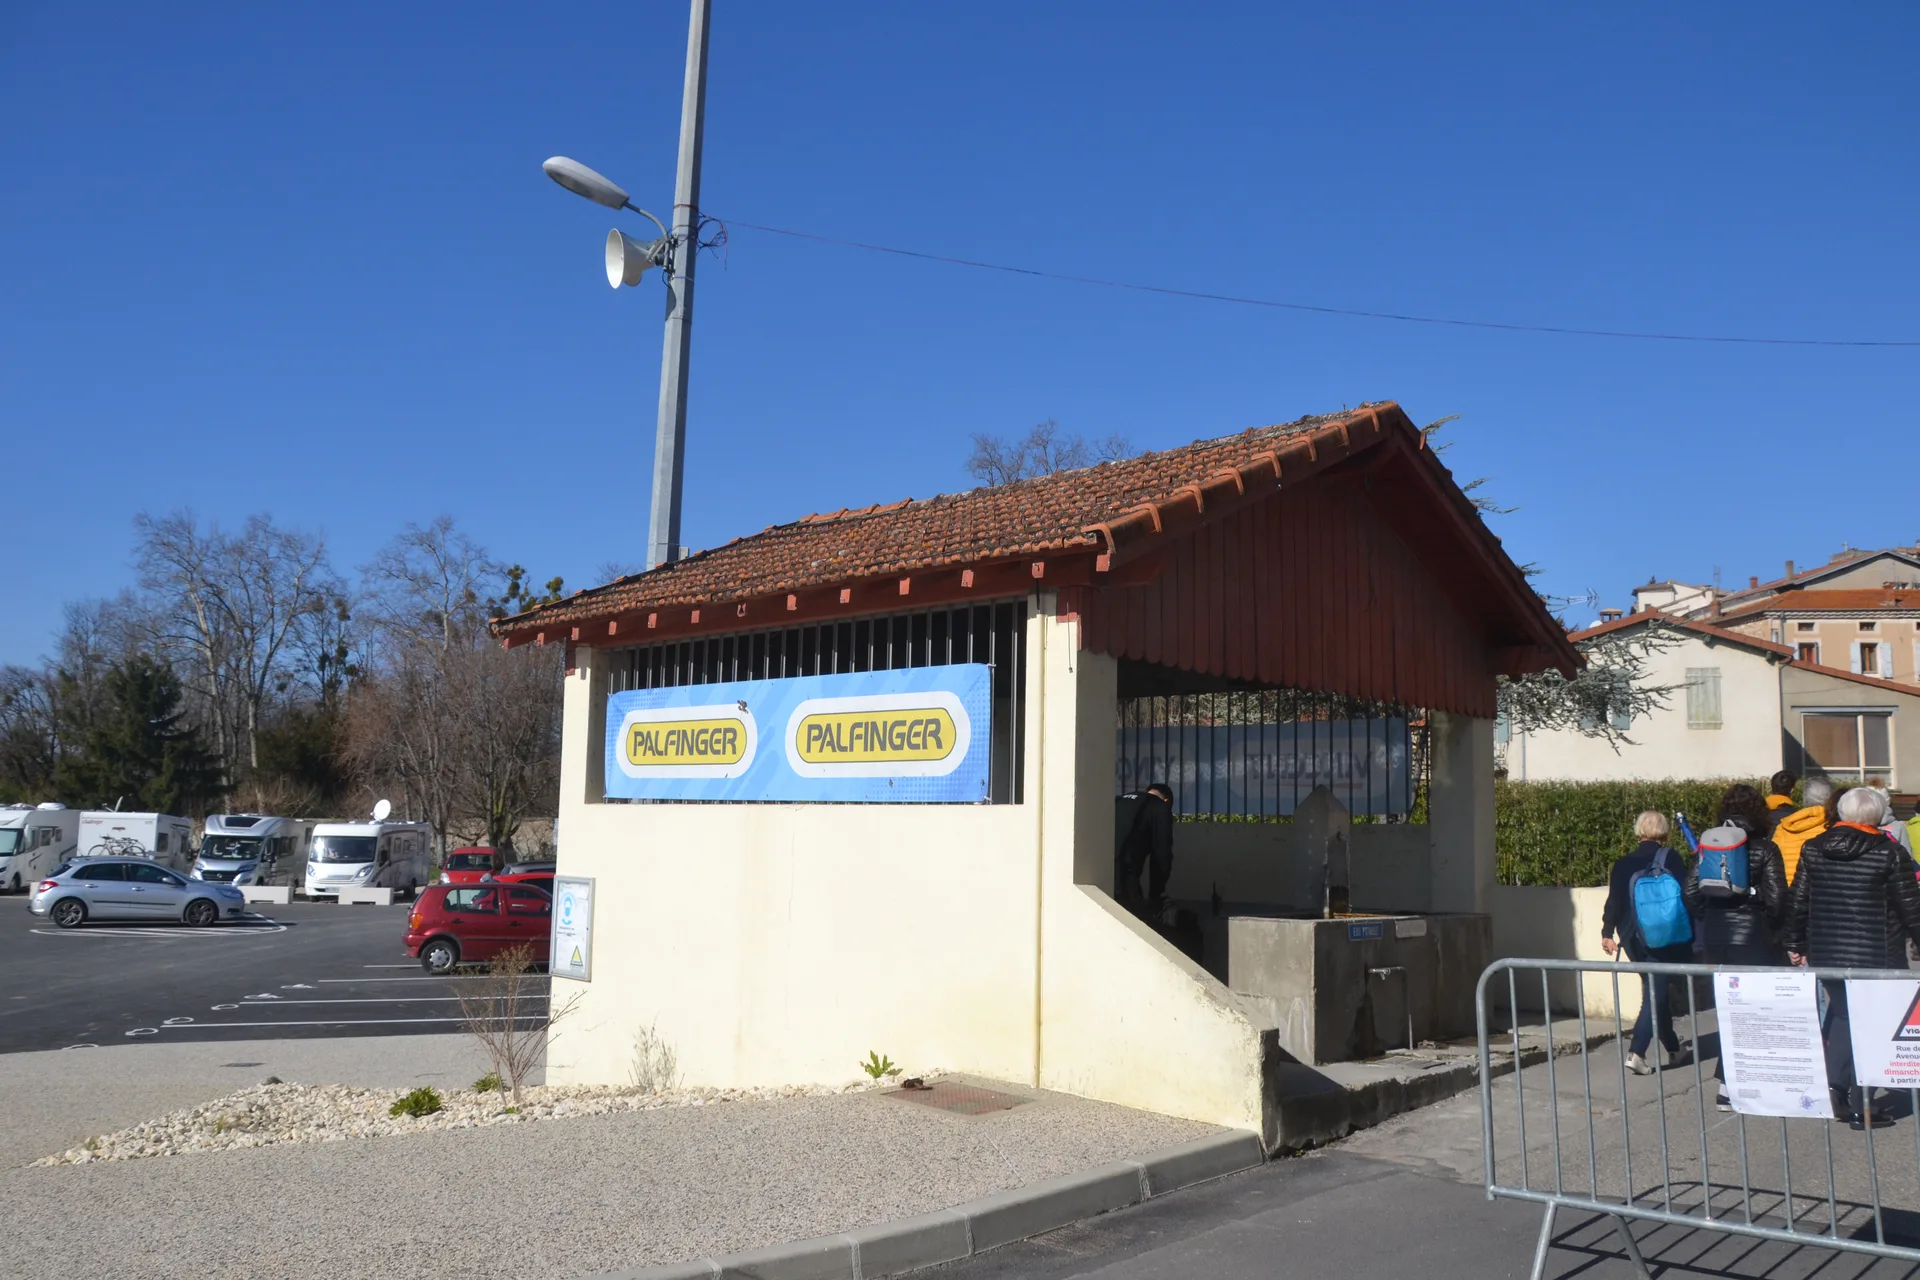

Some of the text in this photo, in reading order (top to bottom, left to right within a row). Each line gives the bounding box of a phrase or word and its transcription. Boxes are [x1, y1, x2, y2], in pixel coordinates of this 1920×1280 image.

[633, 727, 737, 757] PALFINGER
[806, 717, 943, 753] PALFINGER
[1896, 1077, 1917, 1085] partir
